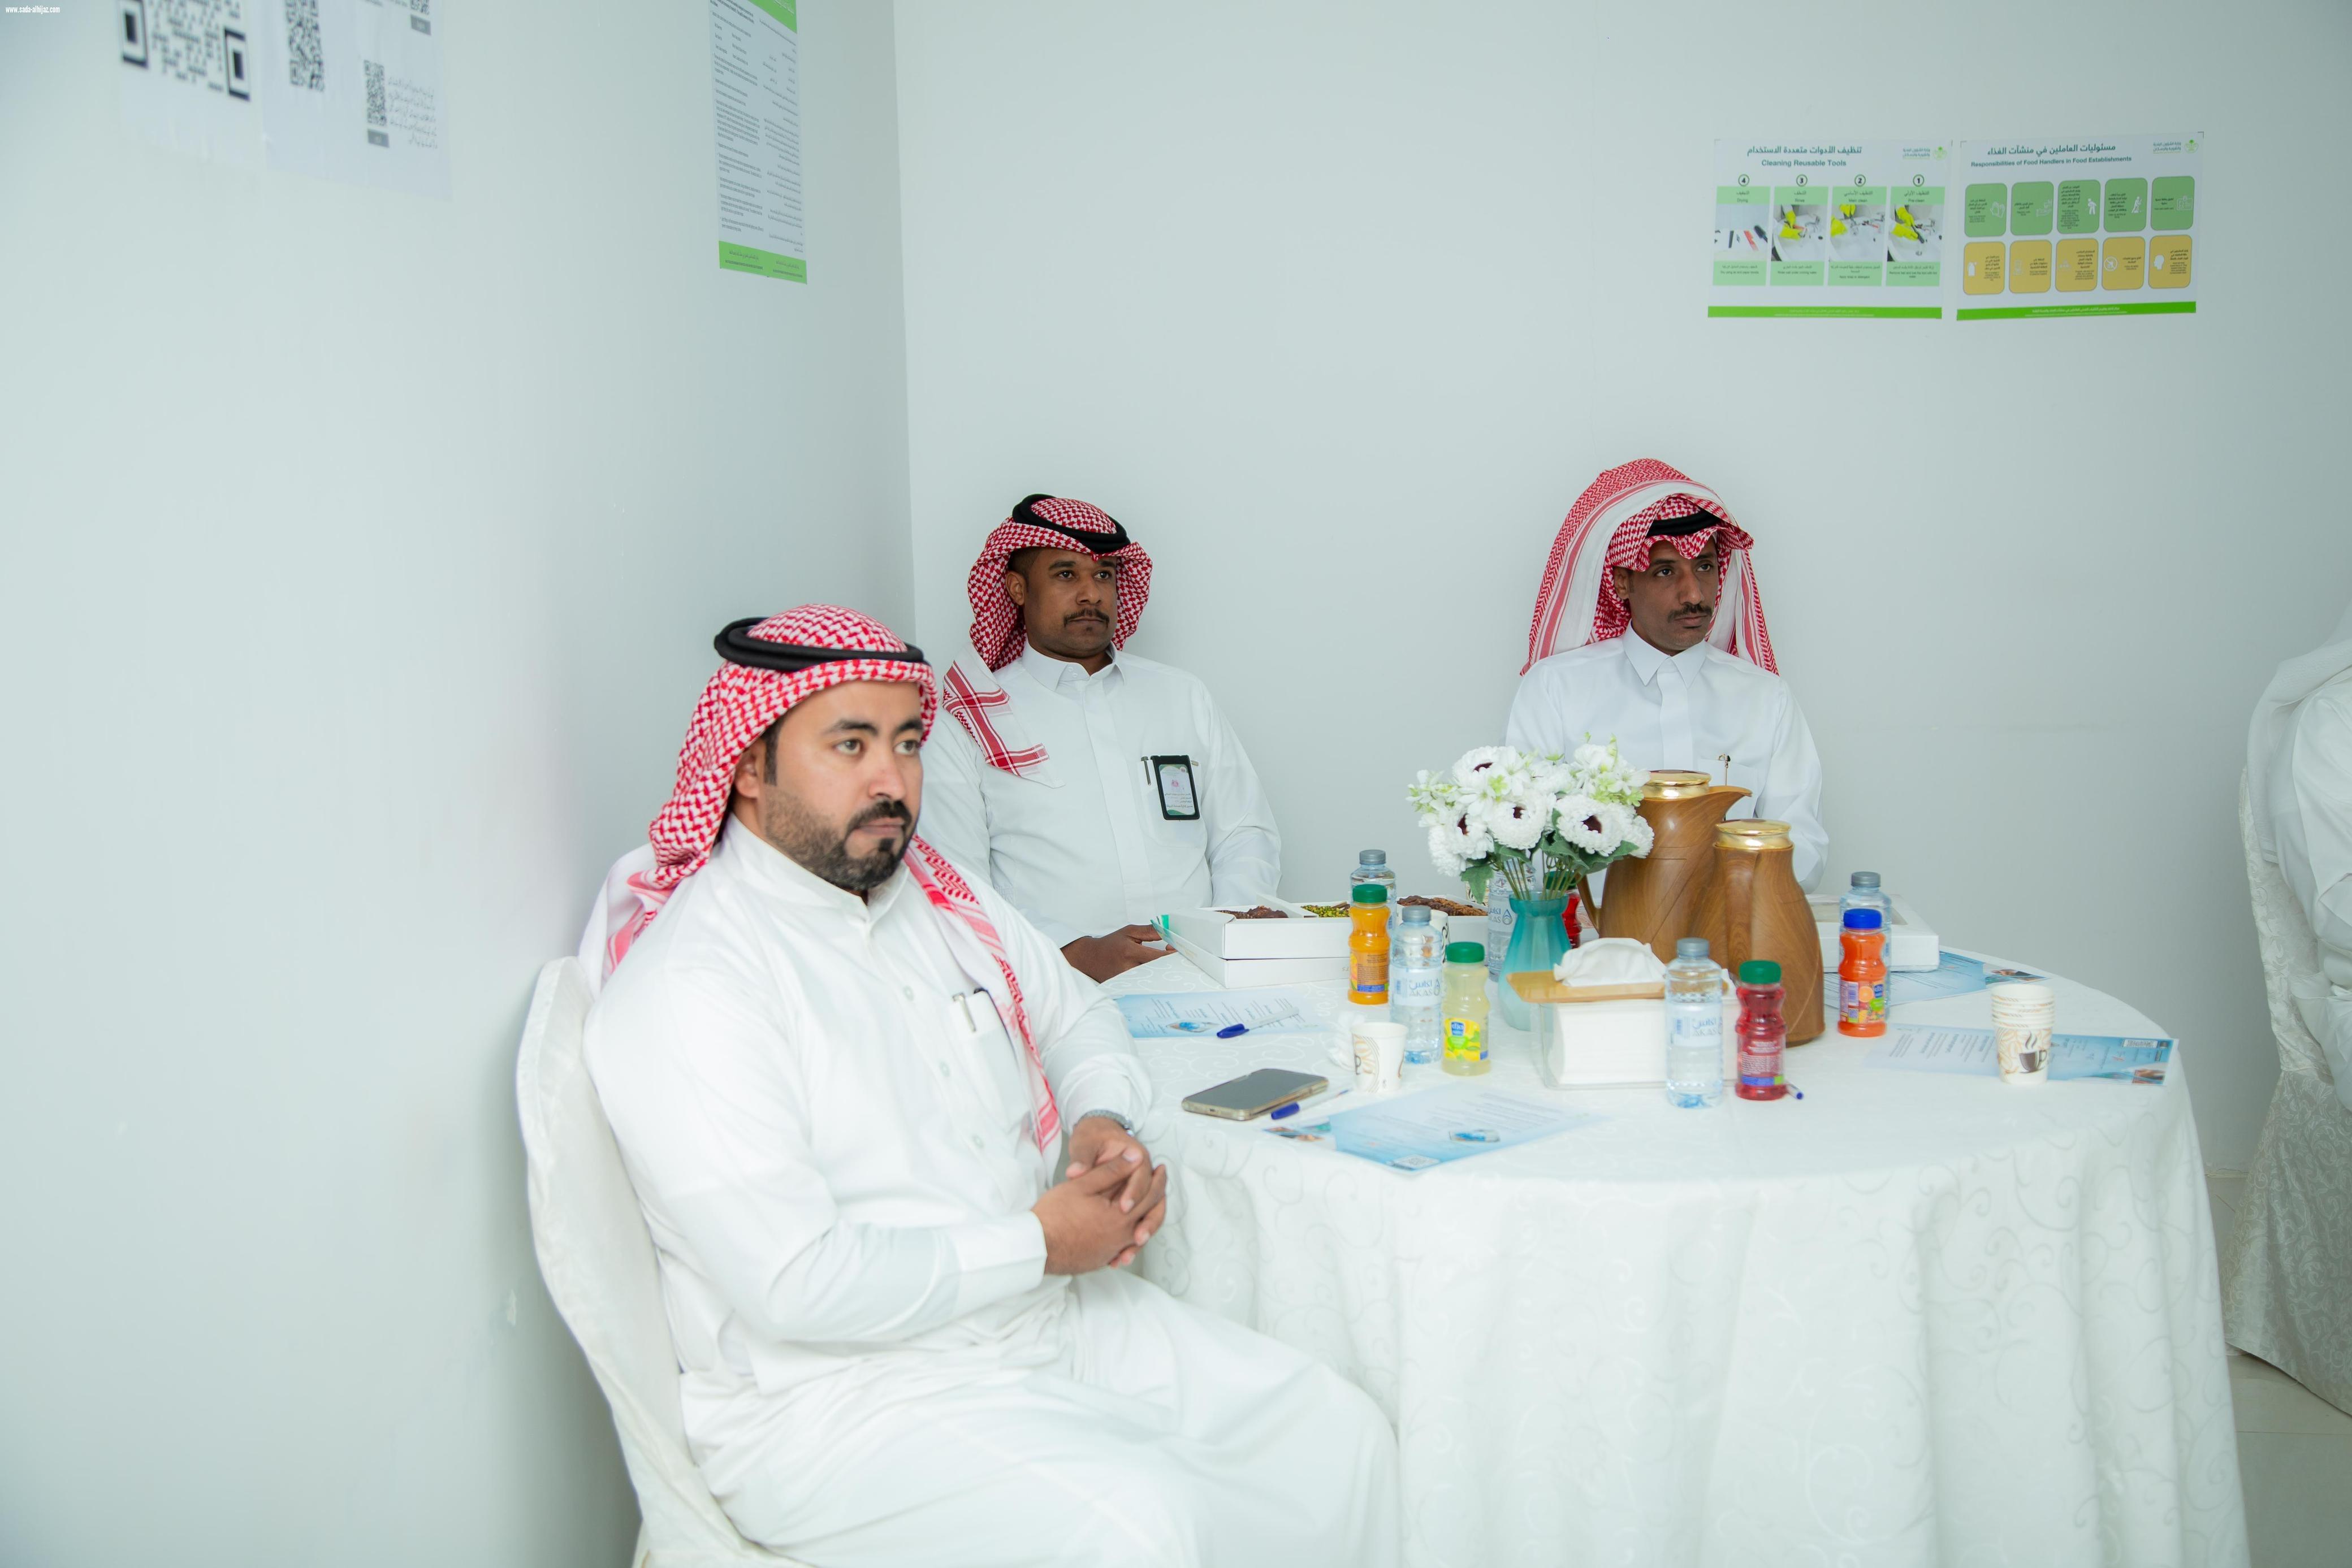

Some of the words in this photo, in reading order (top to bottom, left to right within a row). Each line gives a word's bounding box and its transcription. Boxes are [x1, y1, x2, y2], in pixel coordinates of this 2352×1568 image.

[1783, 146, 1808, 154] متعددة
[1837, 145, 1862, 155] تنظيف
[1987, 147, 2007, 155] الغذاء
[2009, 146, 2034, 154] منشآت
[2036, 146, 2047, 157] في
[2050, 144, 2078, 154] العاملين
[2080, 144, 2116, 153] مسئوليات
[1761, 159, 1792, 168] Cleaning
